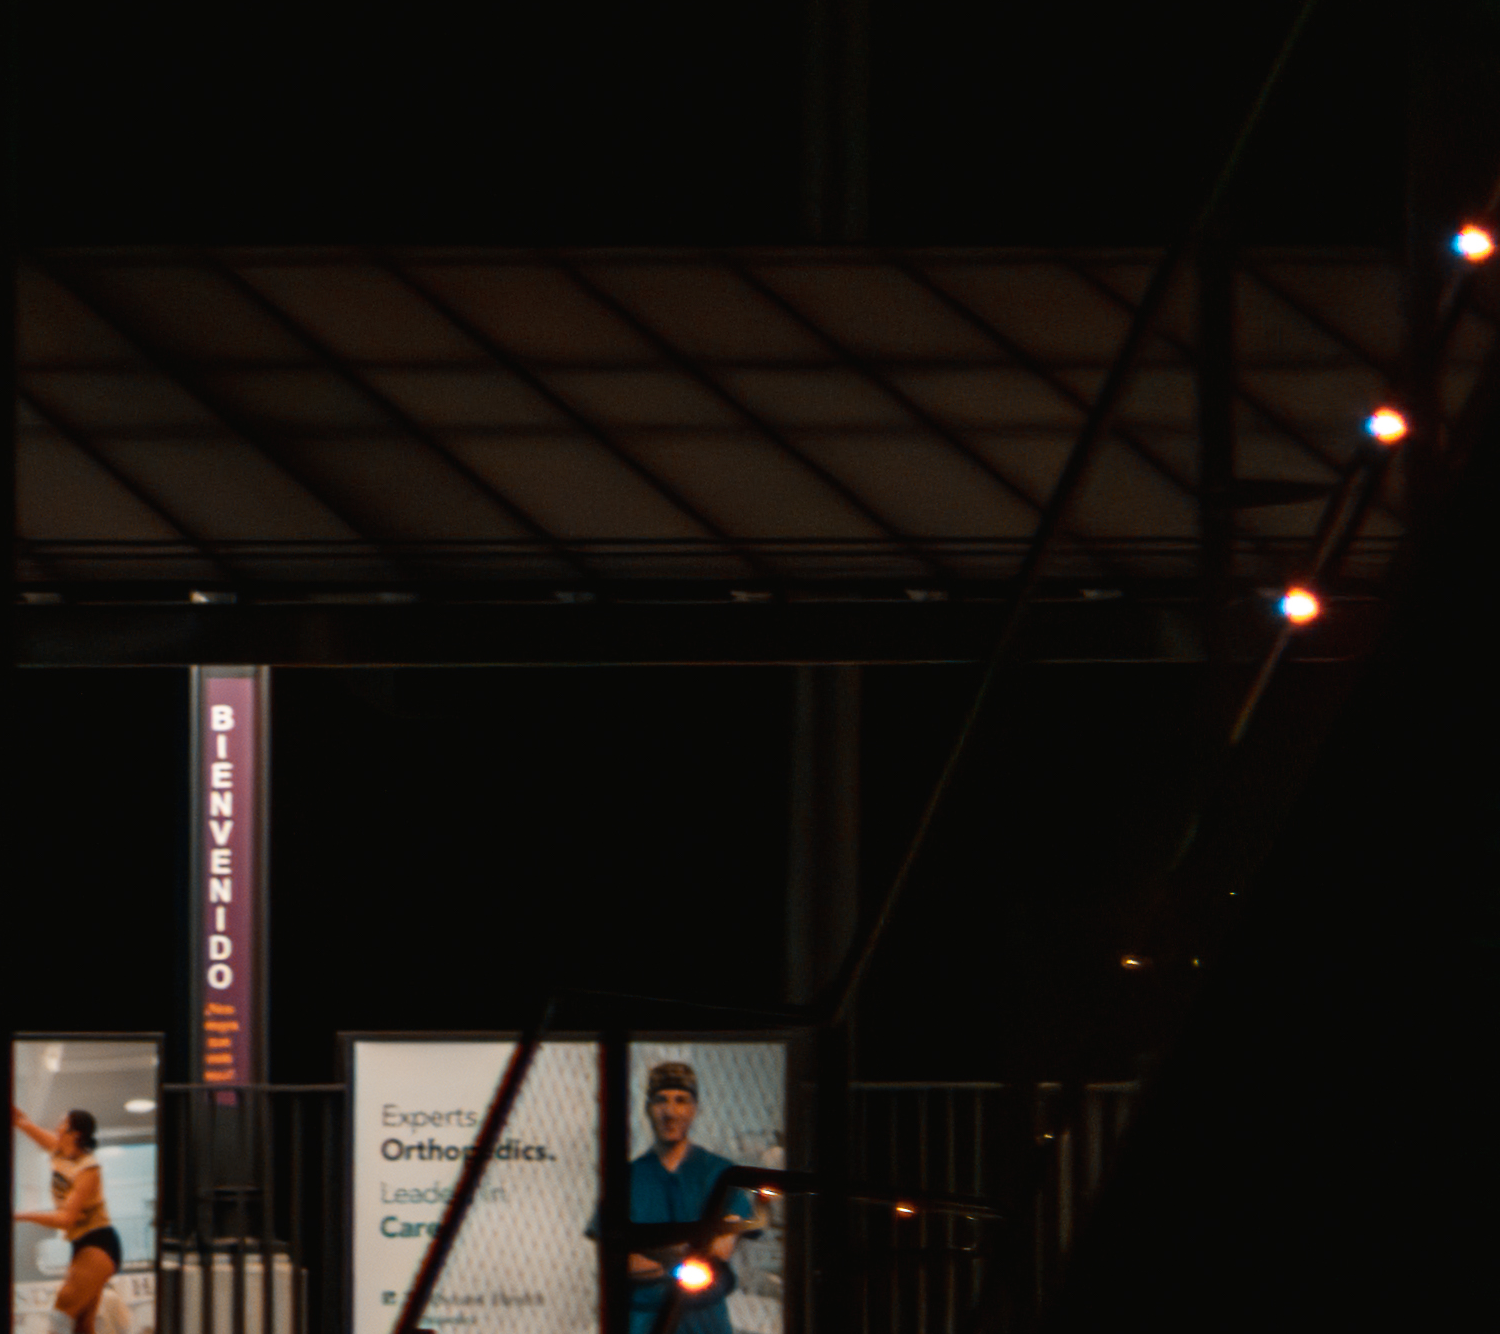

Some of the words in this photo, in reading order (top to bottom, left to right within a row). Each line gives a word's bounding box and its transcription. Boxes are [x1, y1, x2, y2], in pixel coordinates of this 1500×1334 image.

[207, 704, 235, 990] BIENVENIDO
[381, 1103, 479, 1134] Experts
[381, 1137, 558, 1162] Orthodics.
